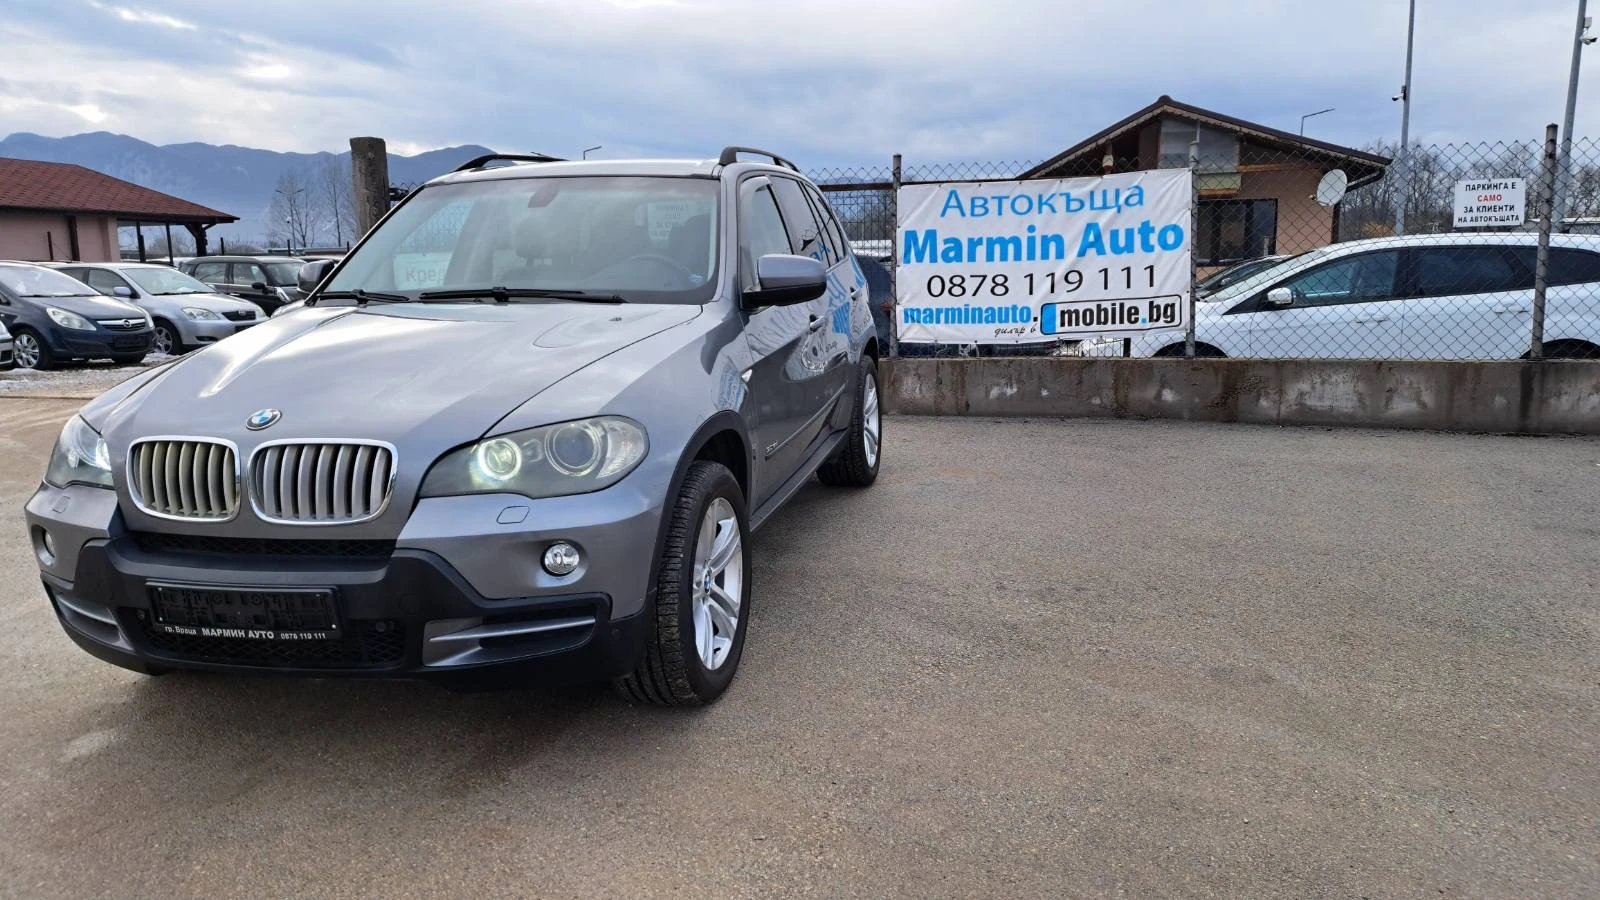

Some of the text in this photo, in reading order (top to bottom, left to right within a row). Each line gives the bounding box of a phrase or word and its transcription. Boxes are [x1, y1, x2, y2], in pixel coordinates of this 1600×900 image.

[1465, 181, 1517, 192] ПАРКИНГА Е
[940, 184, 1145, 218] Автокъща
[1477, 194, 1502, 202] САМО
[1463, 204, 1515, 214] ЗА КЛИЕНТИ
[1469, 214, 1520, 223] АВТОКЪЩАТА
[903, 218, 1184, 264] Marmin Auto
[926, 264, 1155, 298] 0878 119 111
[1060, 300, 1176, 328] mobile.bg
[201, 627, 246, 638] МАРМИН
[248, 630, 275, 639] АУТО
[313, 632, 326, 640] 111
